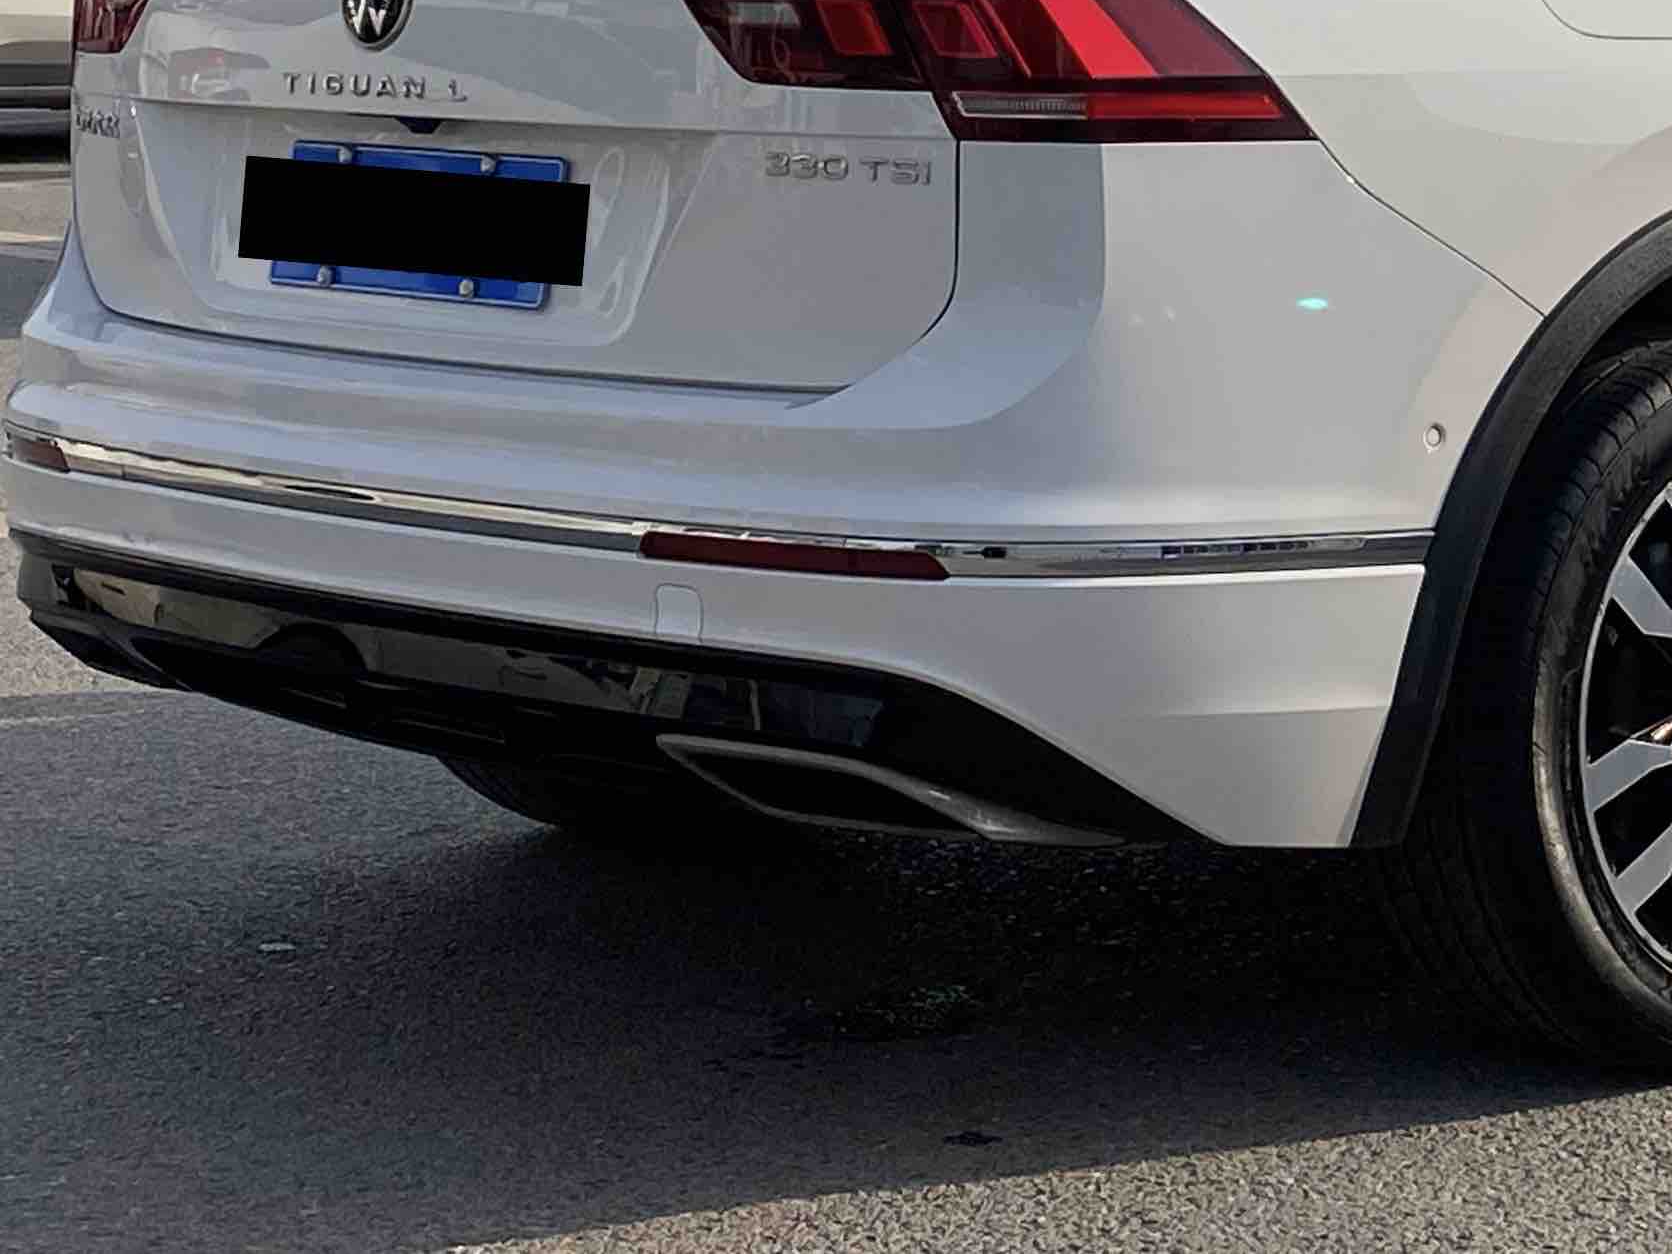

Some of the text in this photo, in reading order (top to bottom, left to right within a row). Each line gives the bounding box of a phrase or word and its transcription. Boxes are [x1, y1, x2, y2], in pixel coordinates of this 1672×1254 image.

[283, 73, 468, 102] TIGUAN L
[765, 151, 933, 186] 330 TSI
